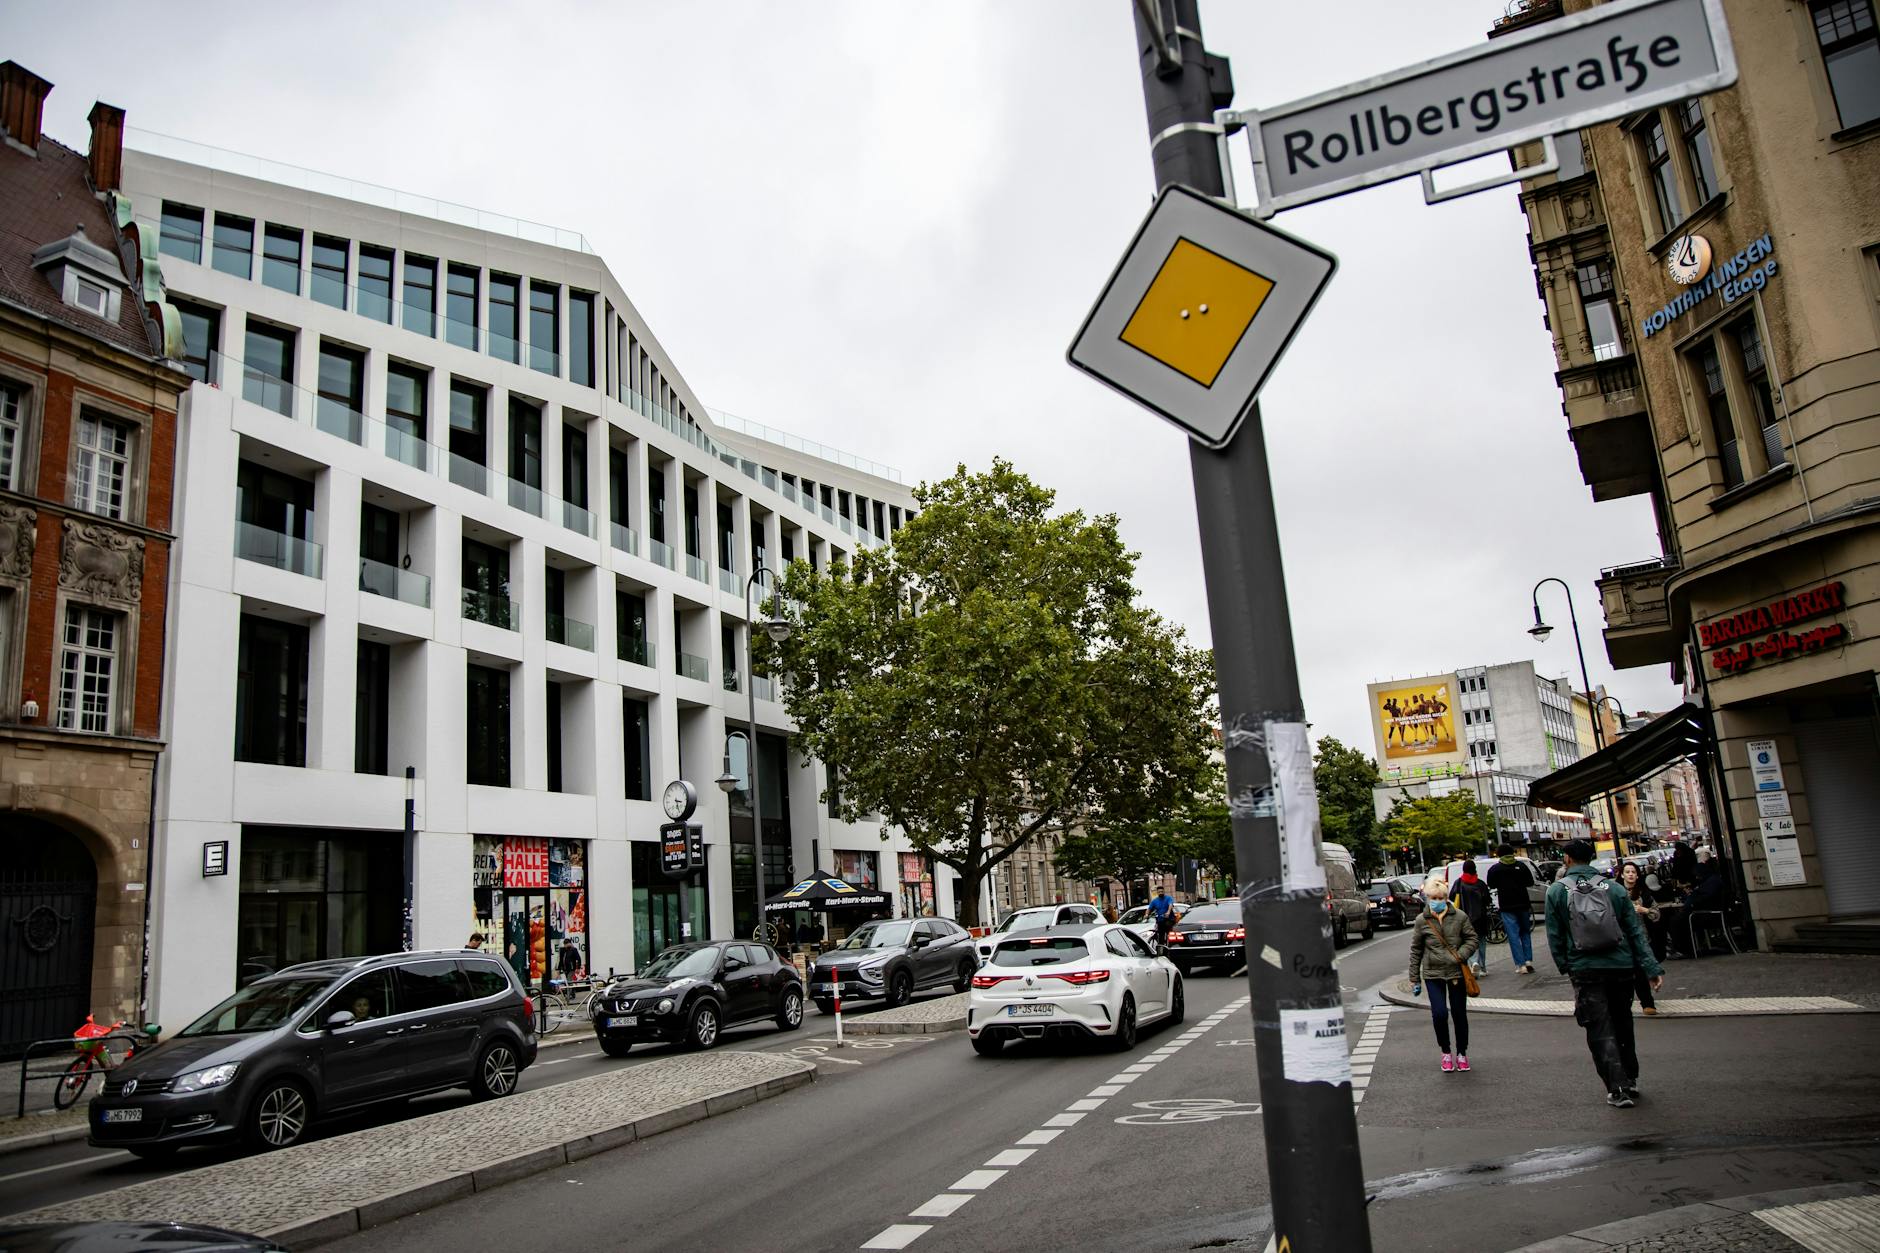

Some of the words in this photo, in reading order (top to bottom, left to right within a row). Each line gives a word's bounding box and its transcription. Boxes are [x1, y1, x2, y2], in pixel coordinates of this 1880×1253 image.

[1283, 34, 1680, 175] Rollbergstraße
[1641, 233, 1774, 338] KONTAKTLINSEN
[1723, 260, 1777, 303] Etage
[1700, 606, 1769, 647] BARAKA
[1769, 582, 1842, 625] MARKT
[504, 854, 549, 870] HALLE
[504, 872, 549, 887] KALLE
[765, 900, 810, 911] arl-Marx-Straße
[825, 896, 884, 906] Karl-Marx-Straße
[1033, 1004, 1052, 1013] 4404
[1315, 1029, 1339, 1038] ALLEN
